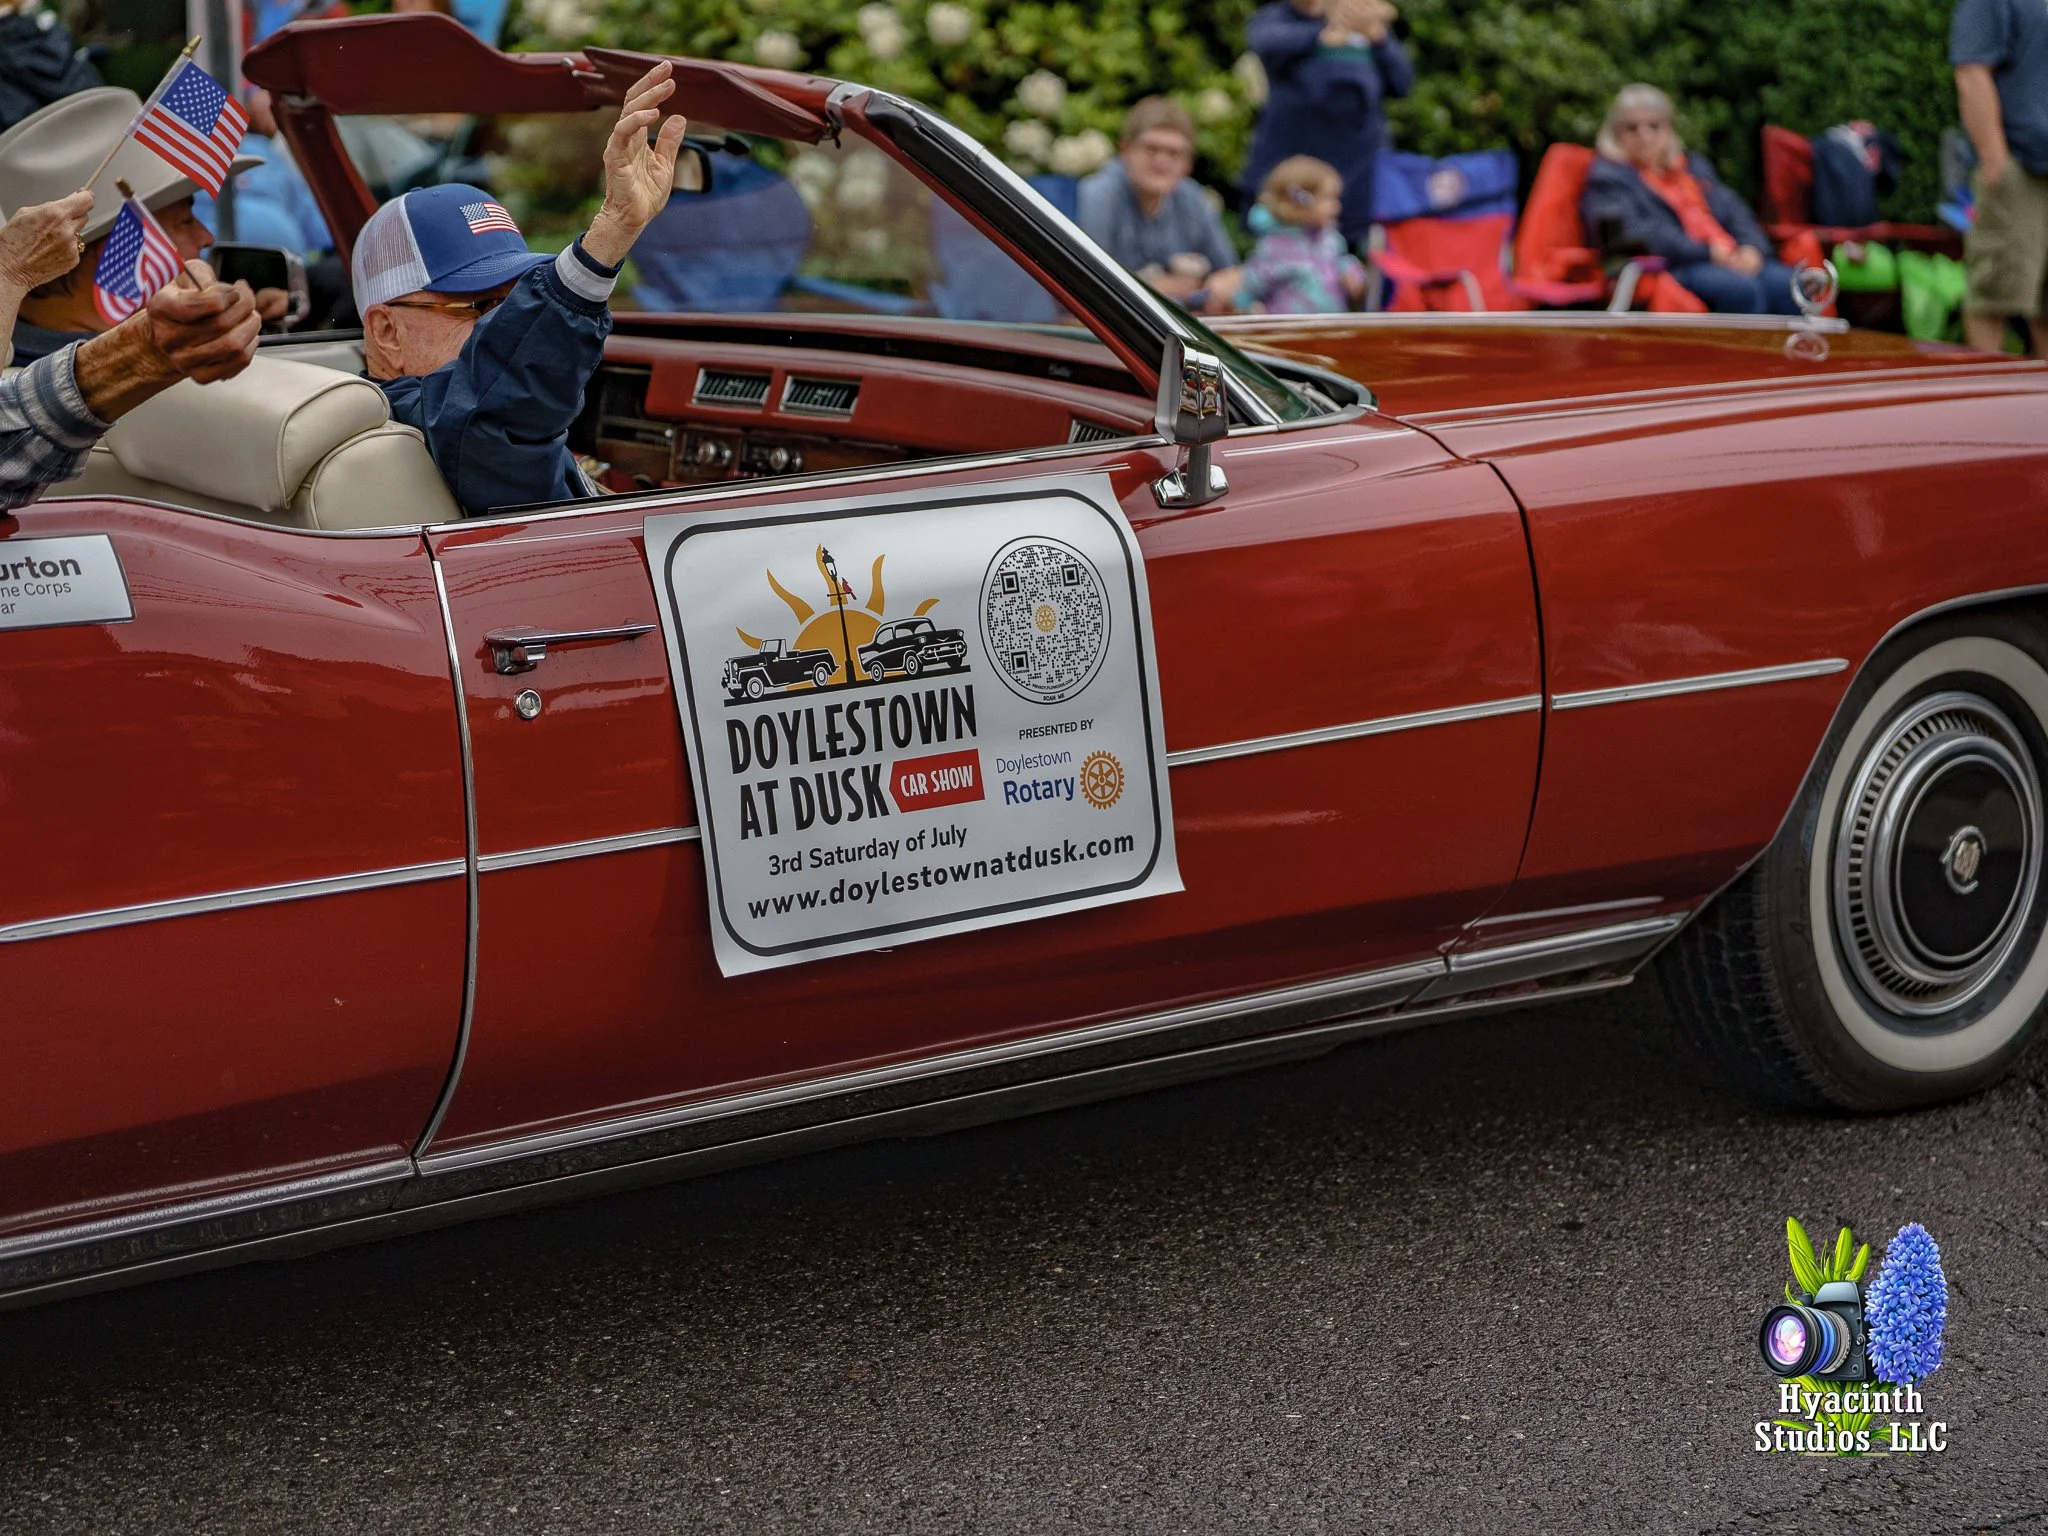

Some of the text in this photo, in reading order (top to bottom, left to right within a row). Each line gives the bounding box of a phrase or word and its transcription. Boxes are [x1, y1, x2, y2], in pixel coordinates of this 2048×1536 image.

[24, 582, 72, 597] Corps
[726, 684, 977, 775] DOYLESTOWN
[1019, 719, 1094, 740] PRESENTED BY
[996, 751, 1072, 775] Doylestown
[900, 765, 974, 797] CAR SHOW
[1003, 777, 1075, 805] Rotary
[740, 763, 890, 840] AT DUSK
[768, 824, 967, 876] 3rd Saturday of July
[747, 834, 1135, 919] www.doylestownatdusk.com
